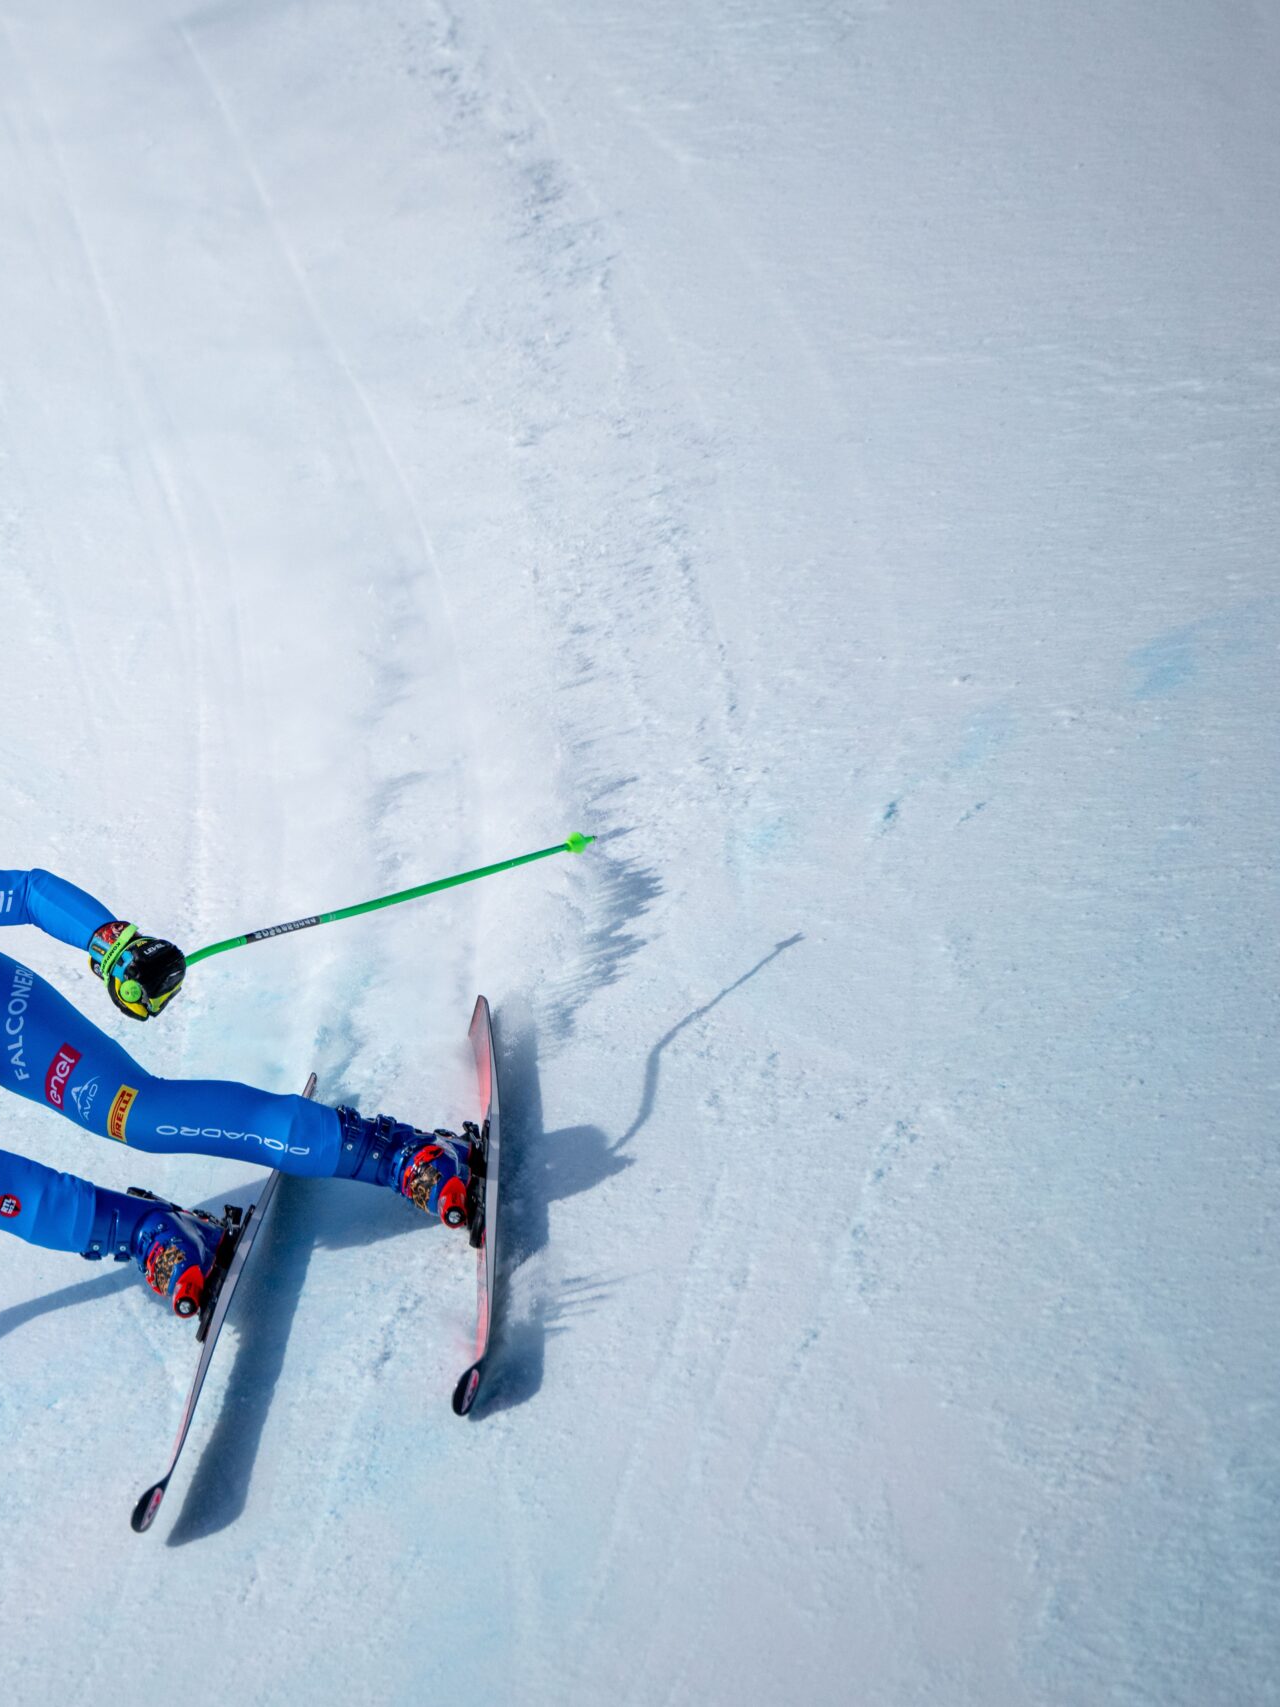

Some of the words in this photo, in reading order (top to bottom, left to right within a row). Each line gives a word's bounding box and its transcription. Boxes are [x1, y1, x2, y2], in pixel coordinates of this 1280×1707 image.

[49, 1052, 75, 1105] enel
[82, 1082, 98, 1121] AVIO
[110, 1089, 133, 1139] PIRELLI
[156, 1125, 310, 1156] PIQUADRO
